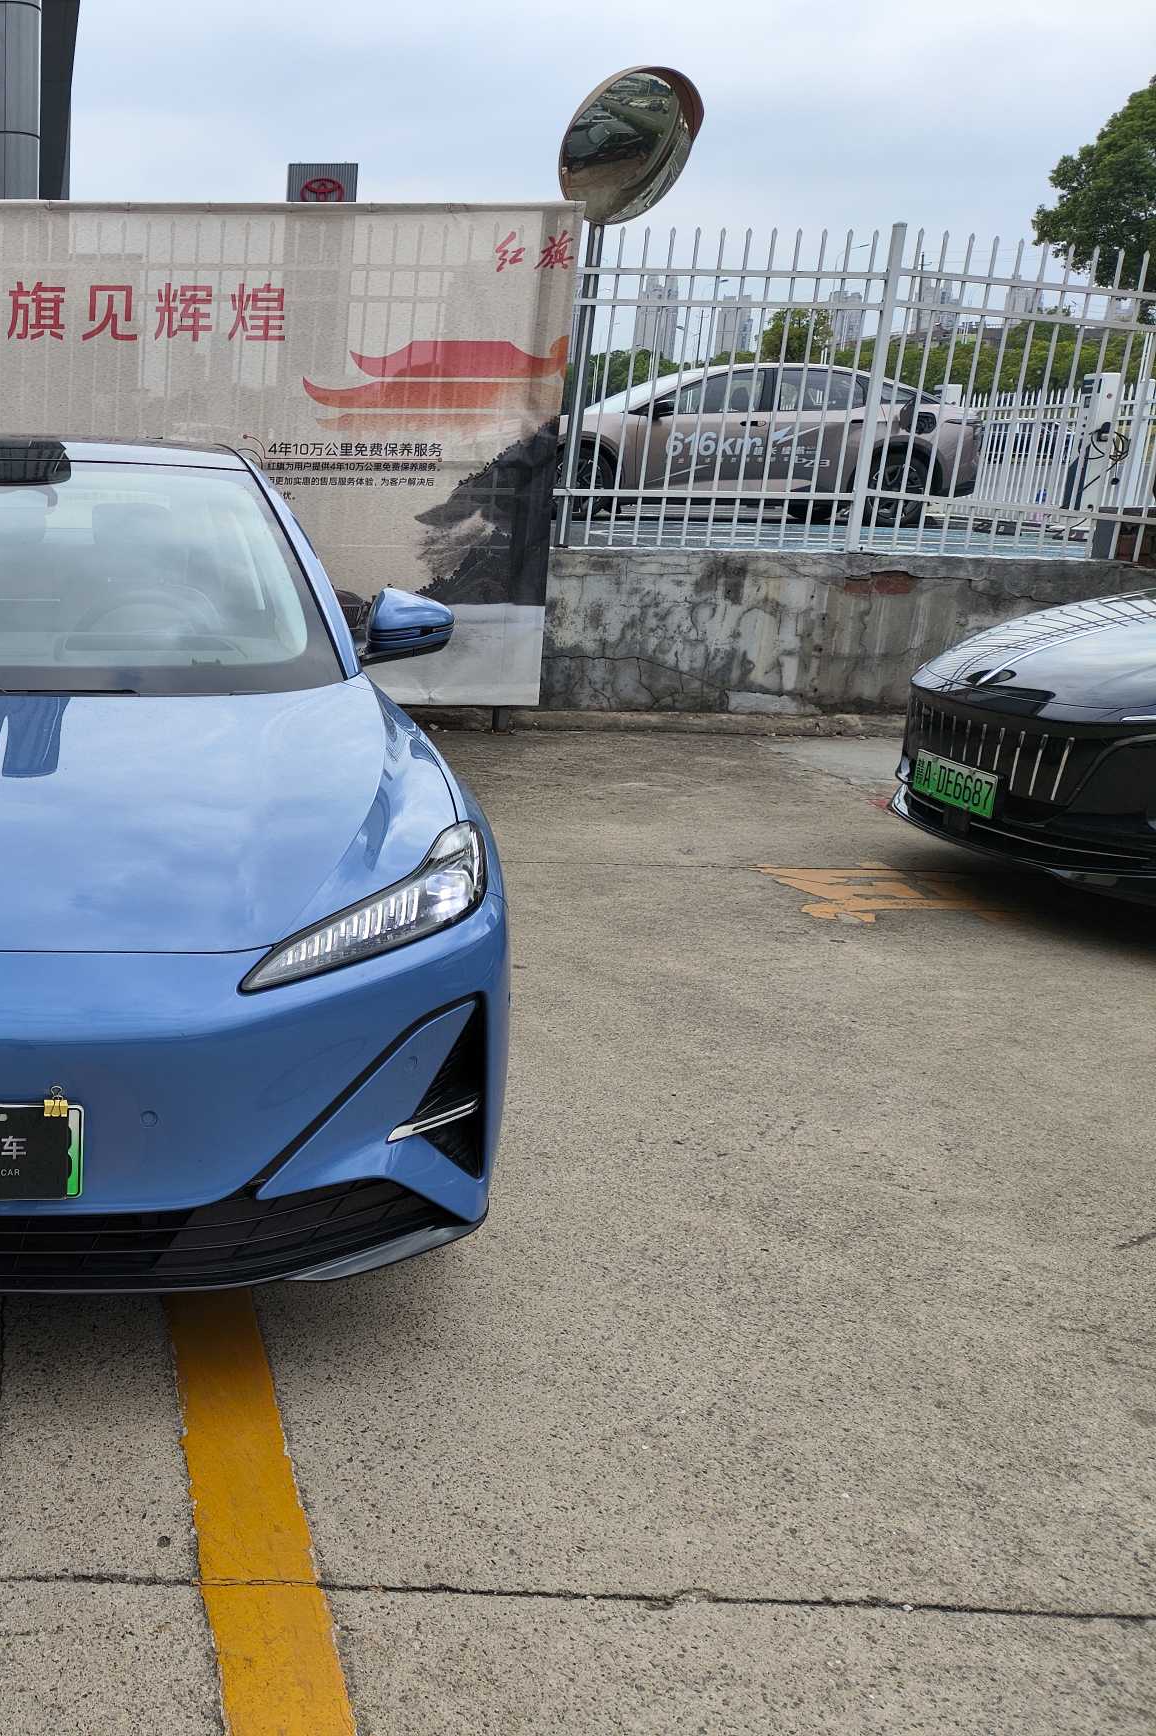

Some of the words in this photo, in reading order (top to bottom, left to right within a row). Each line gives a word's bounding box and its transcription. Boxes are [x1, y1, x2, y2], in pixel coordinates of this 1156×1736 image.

[495, 230, 574, 272] 红旗
[7, 281, 286, 342] 旗见辉煌
[268, 443, 443, 457] 4年10万公里免费保养服务
[0, 1168, 20, 1177] CAR
